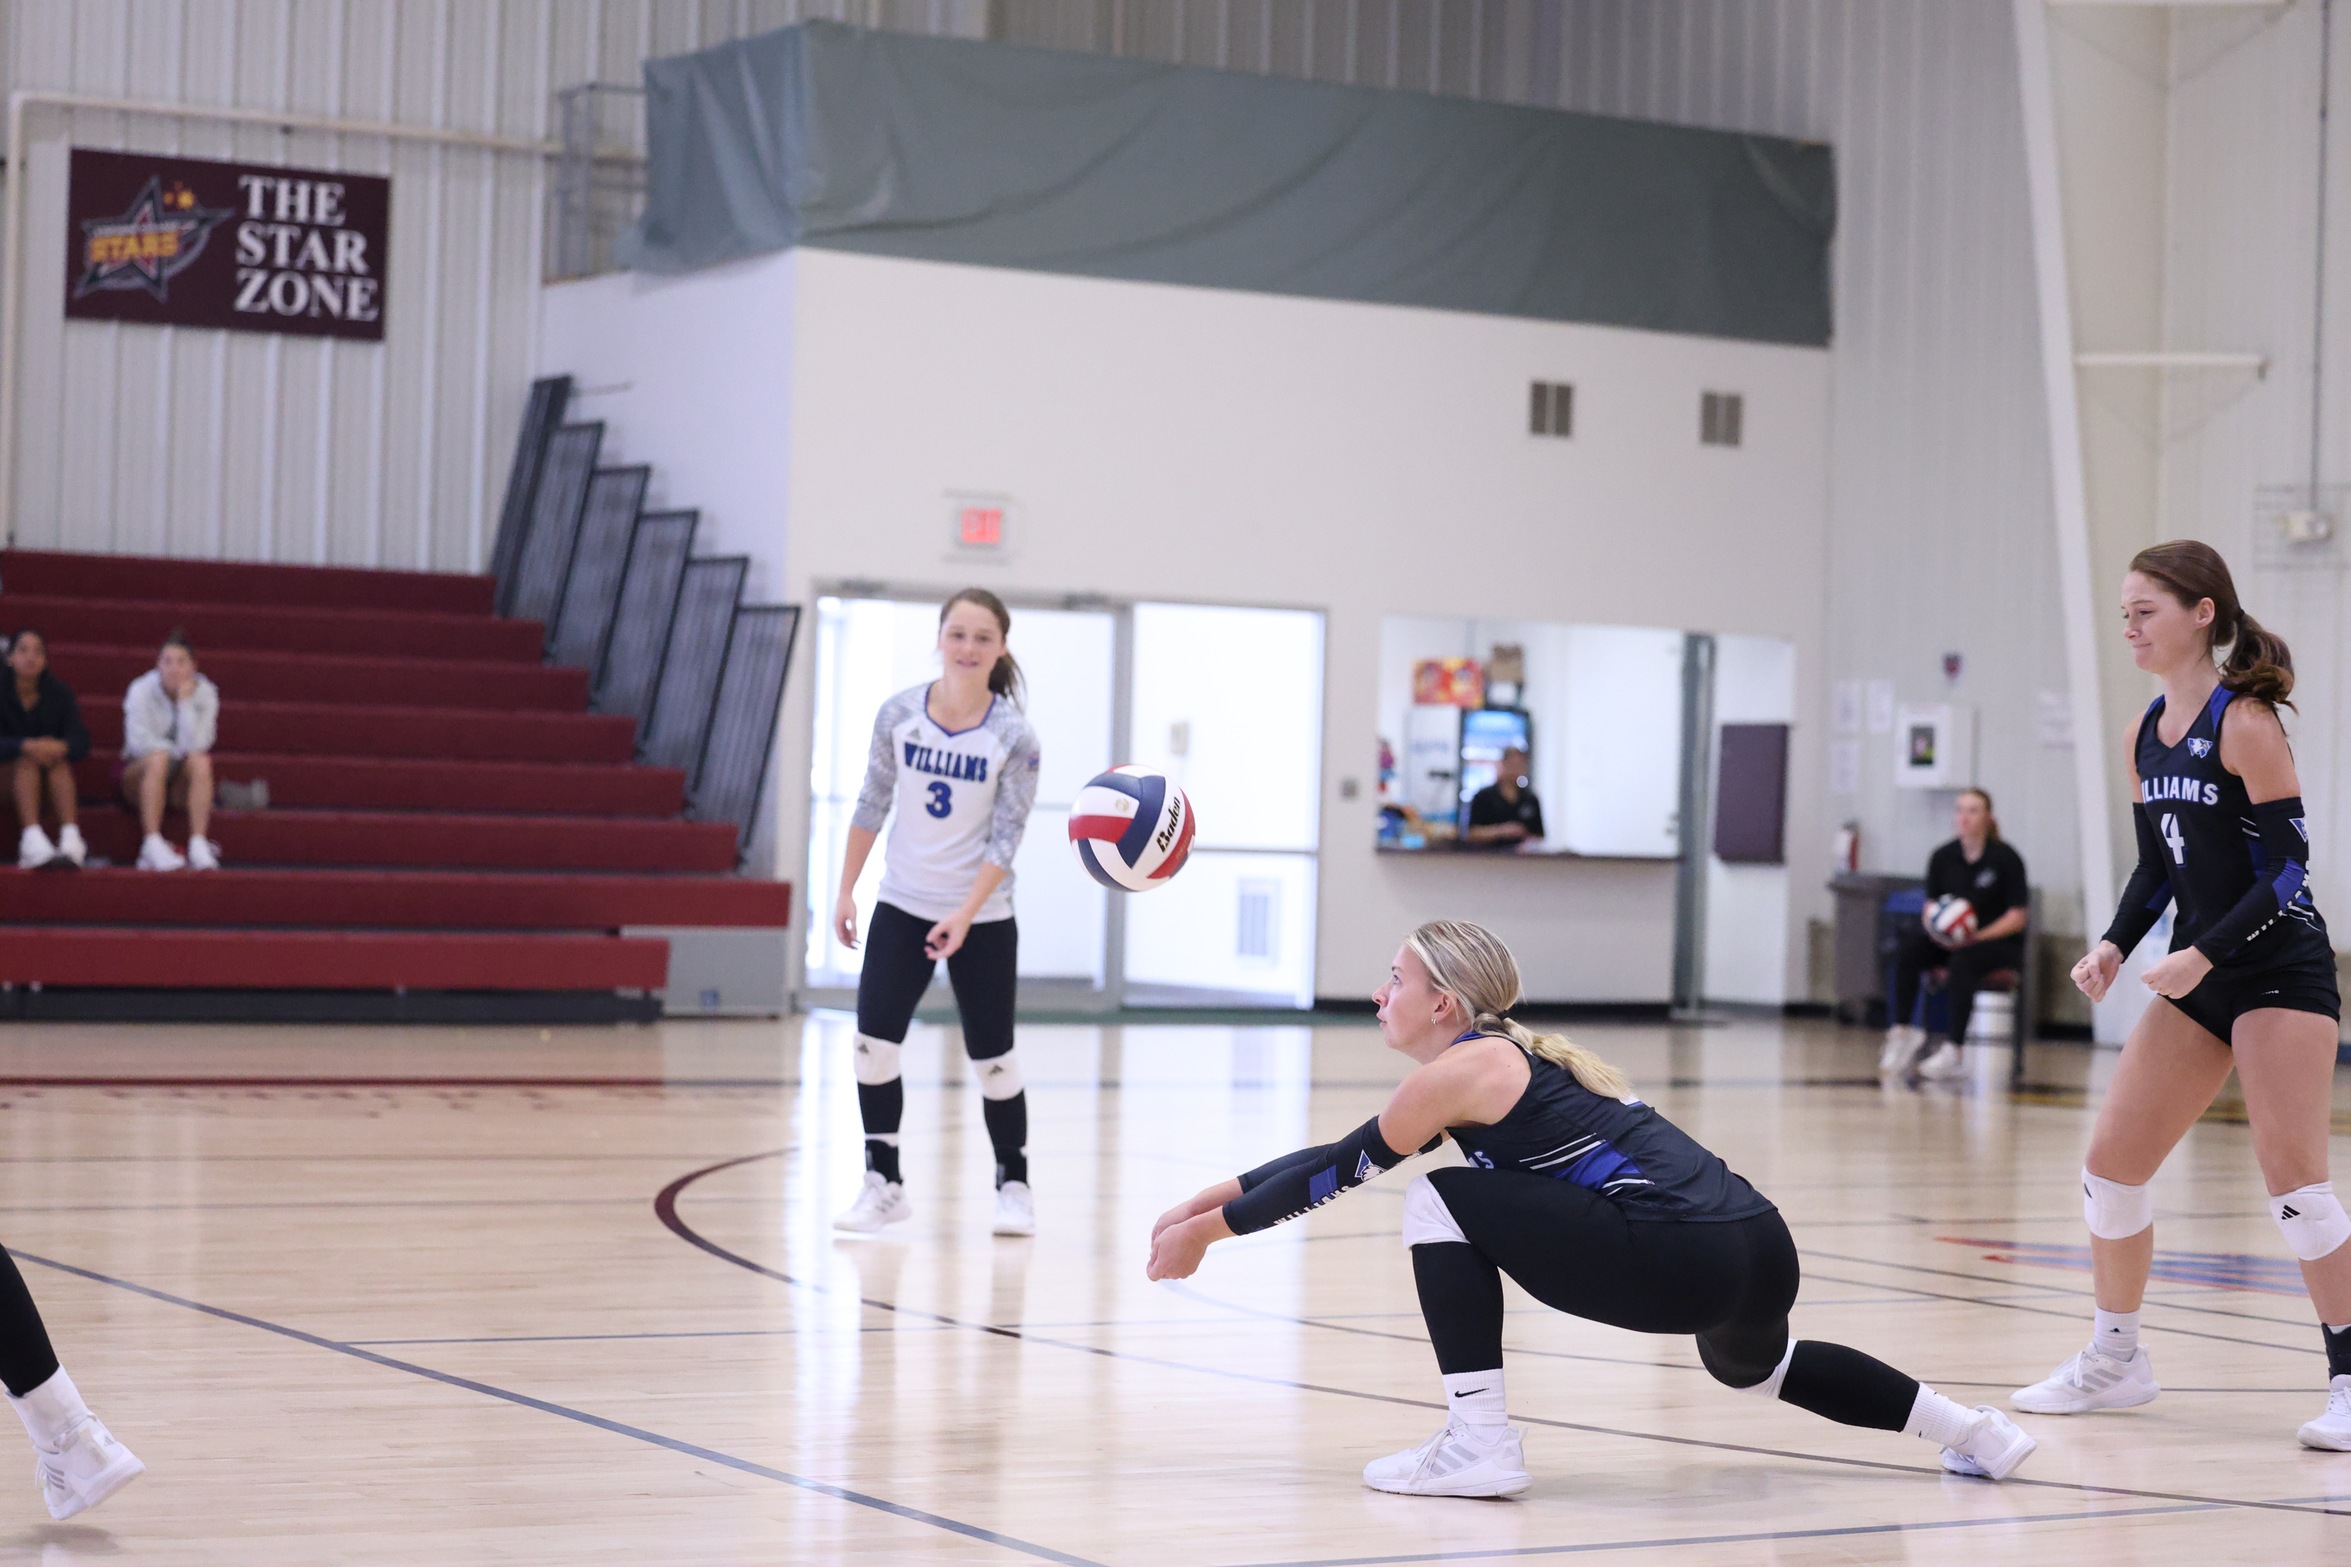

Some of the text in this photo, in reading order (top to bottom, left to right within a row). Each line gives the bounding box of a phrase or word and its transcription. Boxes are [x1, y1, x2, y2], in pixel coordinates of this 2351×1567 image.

[237, 174, 347, 227] THE
[235, 220, 370, 276] STAR
[234, 268, 380, 322] ZONE
[905, 742, 987, 782] WILLIAMS
[926, 781, 952, 819] 3
[2141, 776, 2219, 806] ILLIAMS
[1156, 796, 1181, 853] Baden
[2160, 812, 2186, 866] 4
